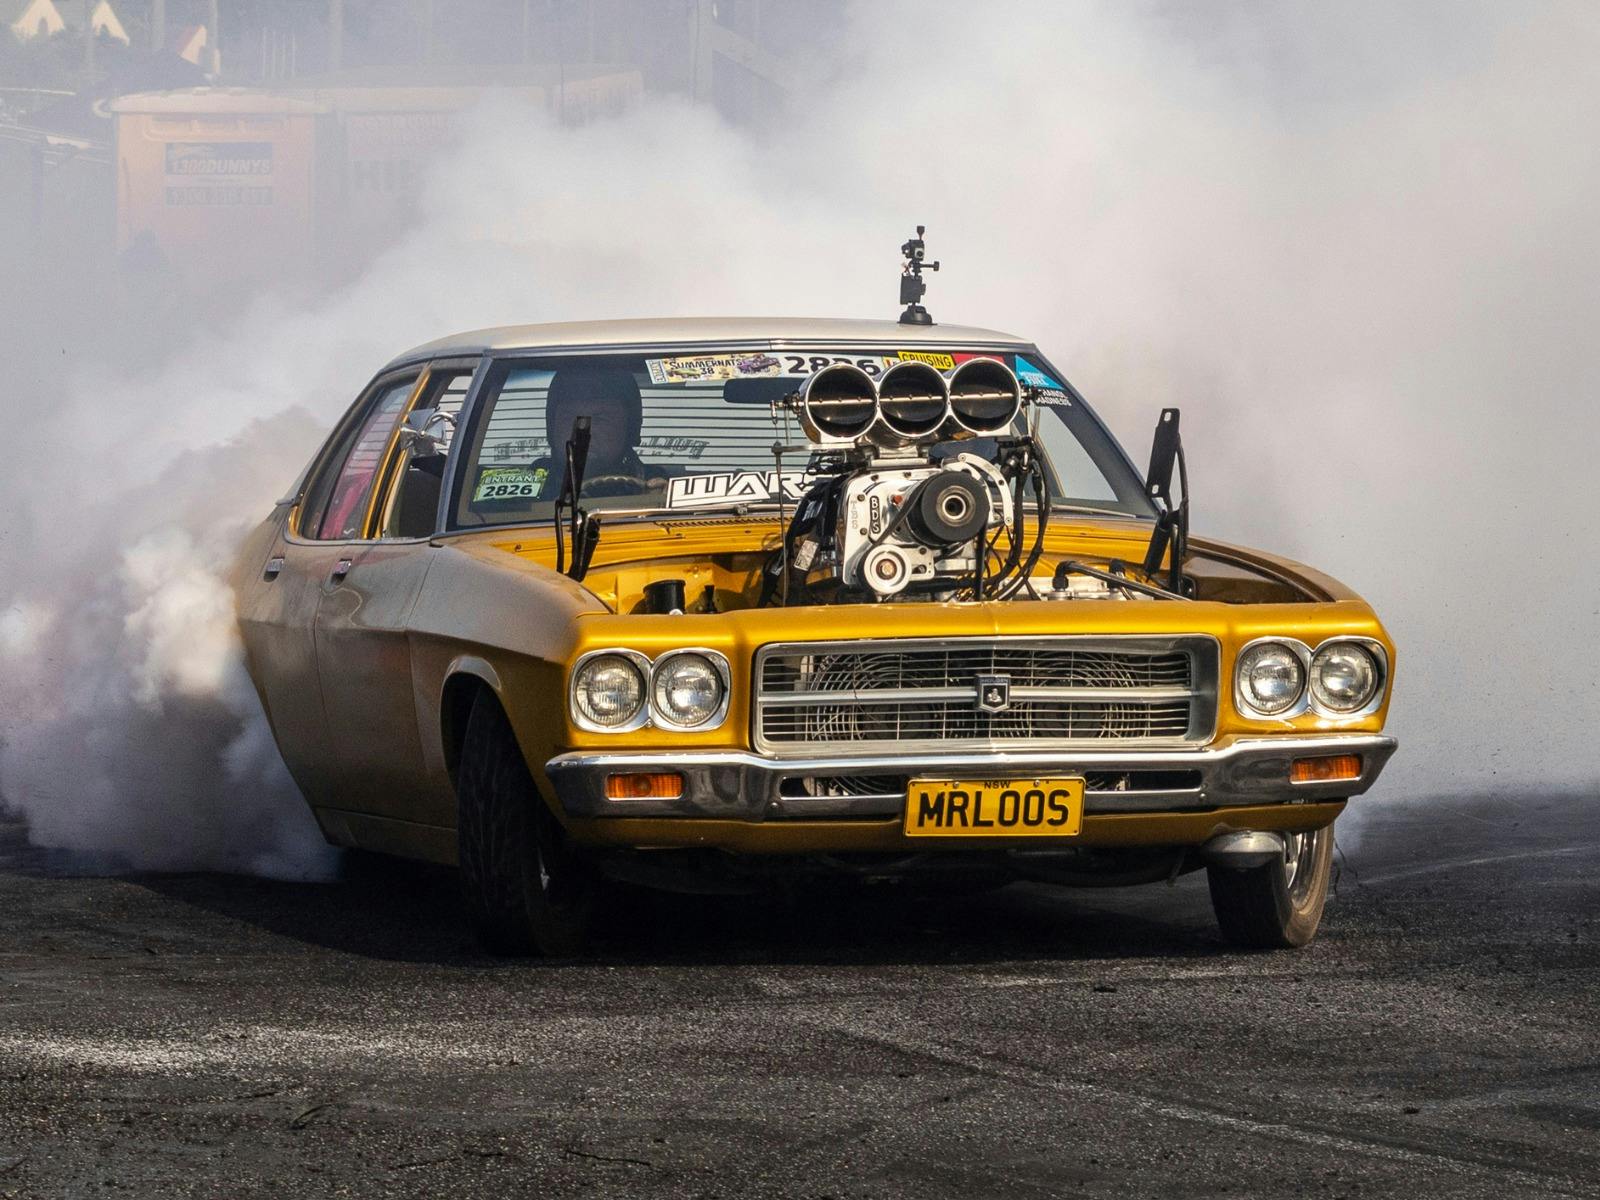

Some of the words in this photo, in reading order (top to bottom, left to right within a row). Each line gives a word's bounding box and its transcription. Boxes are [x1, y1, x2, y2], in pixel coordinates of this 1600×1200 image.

[669, 358, 744, 370] SUMMERNATS
[902, 353, 952, 368] CRUISING
[701, 367, 715, 375] 38
[484, 473, 538, 484] ENTRANT
[483, 485, 533, 497] 2826
[870, 497, 880, 533] BDS
[984, 781, 1011, 789] NSW
[917, 789, 1071, 828] MRLOOS
